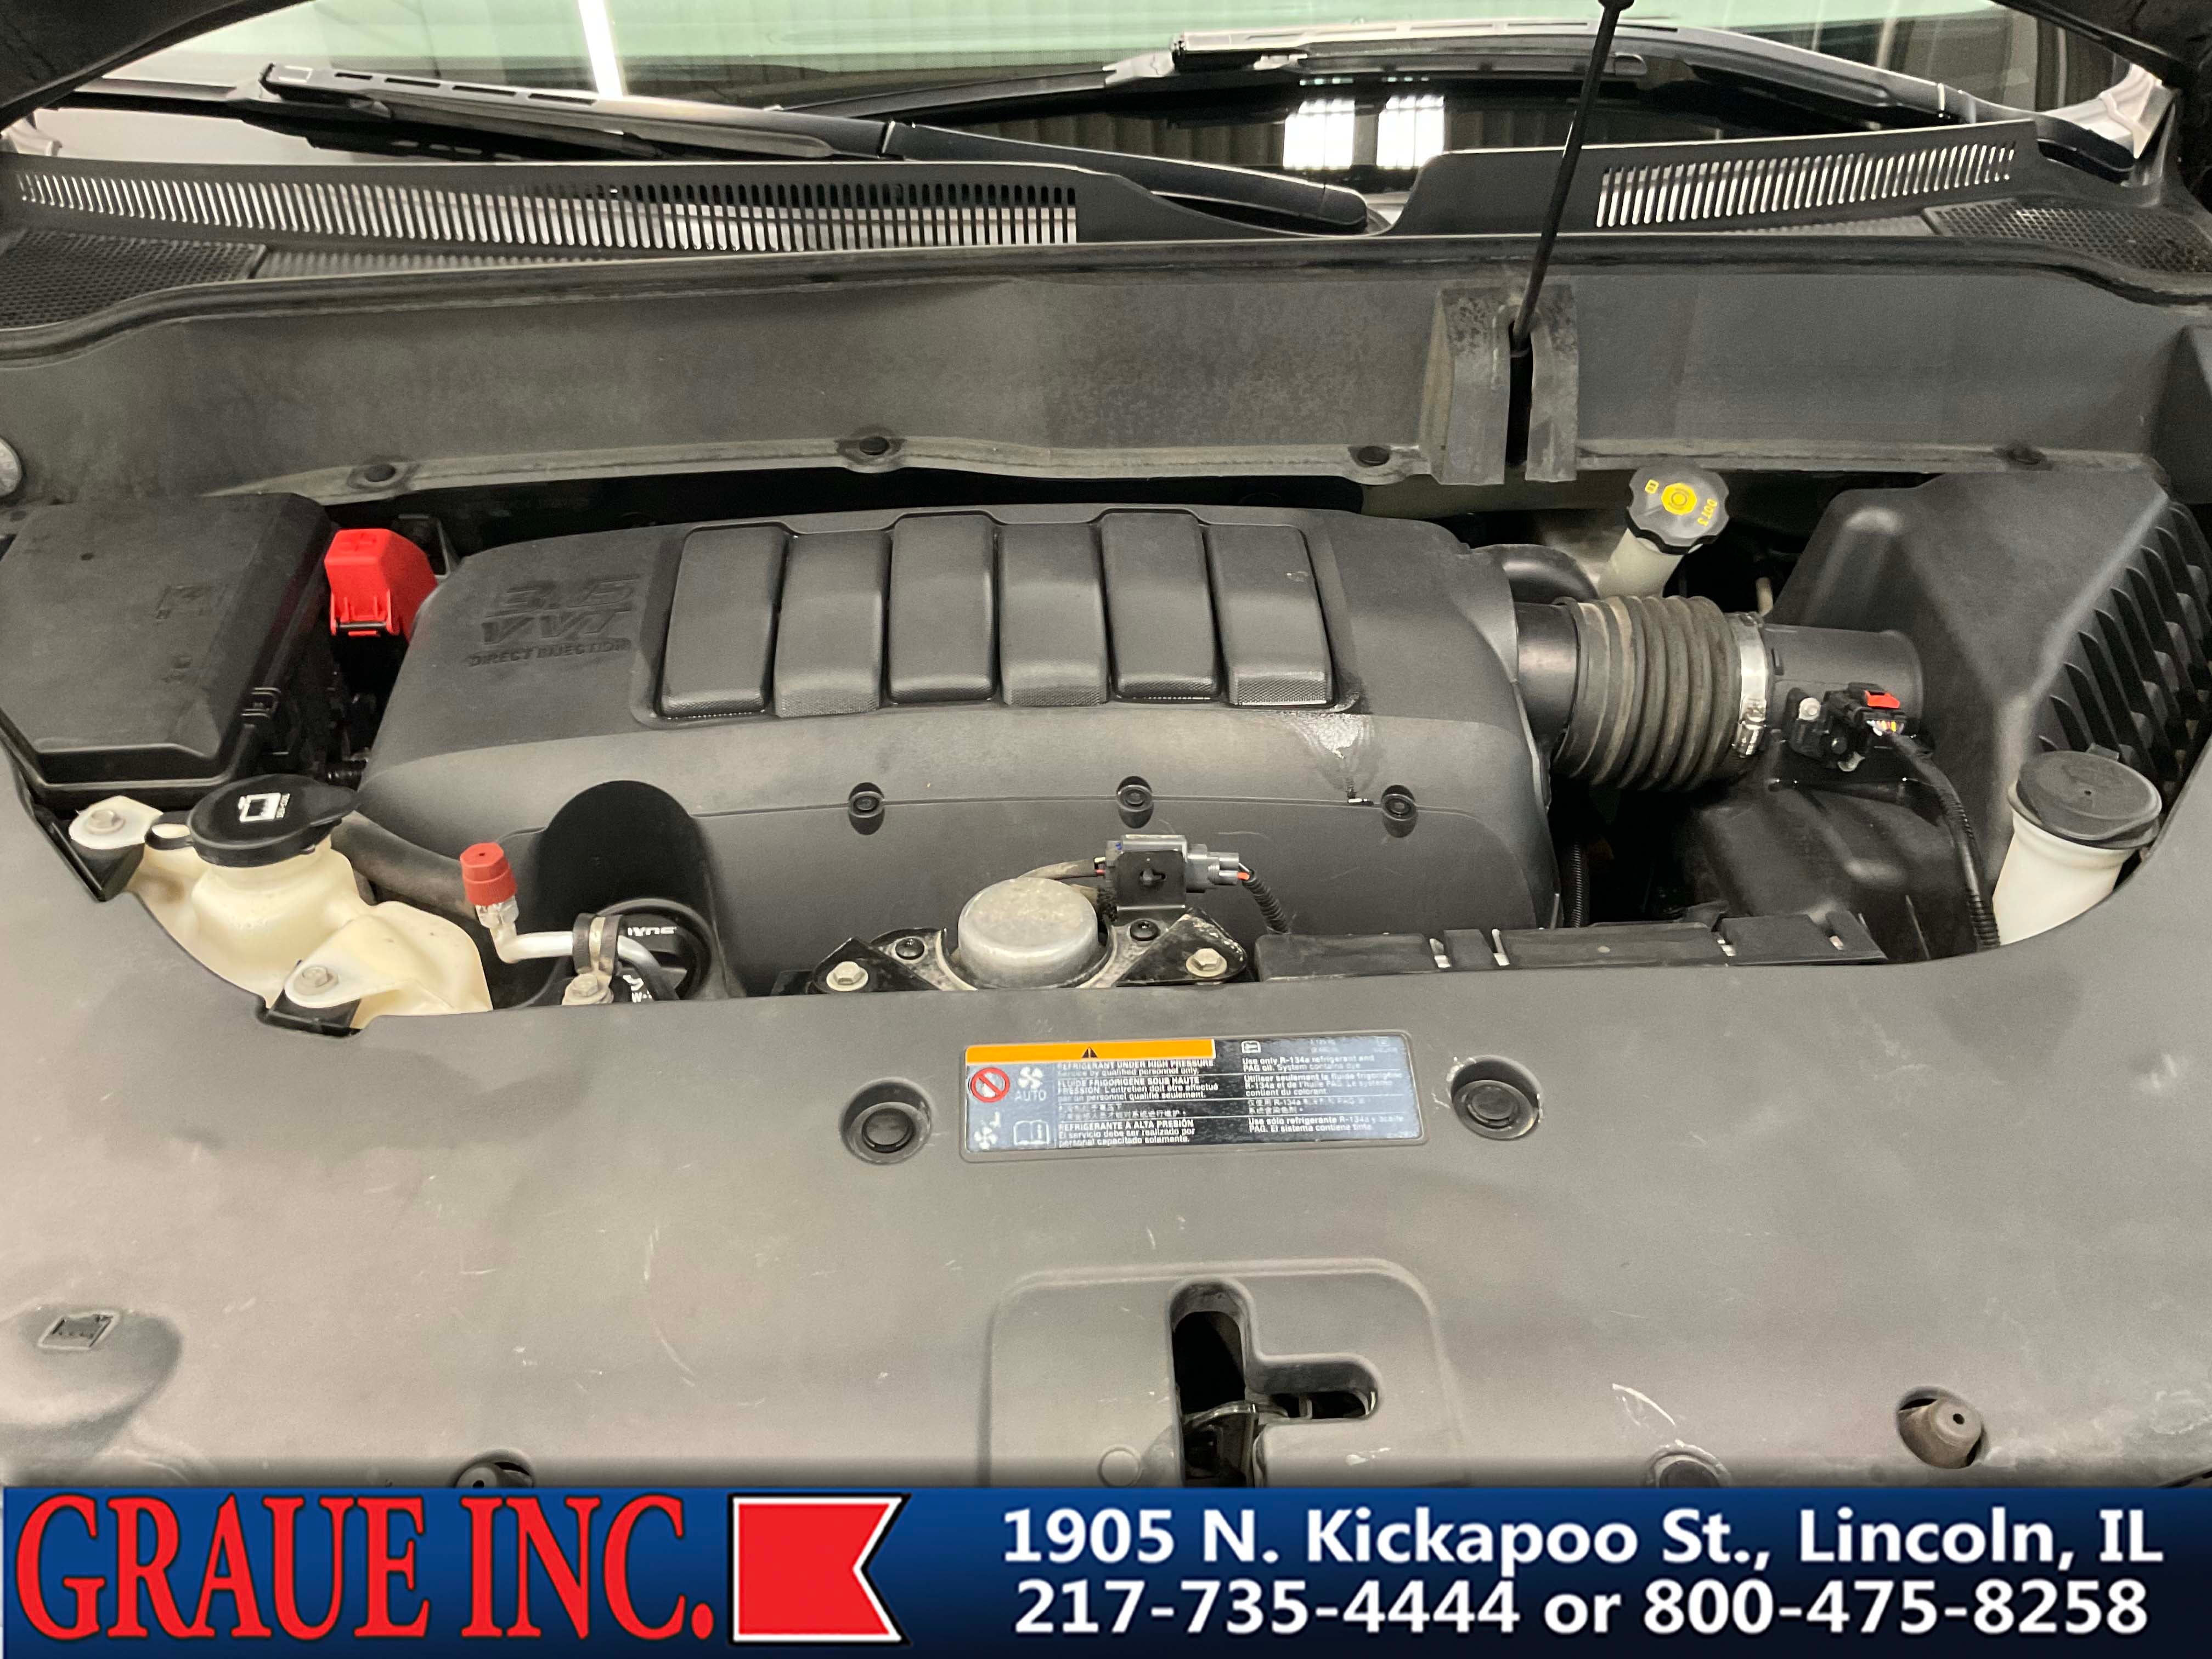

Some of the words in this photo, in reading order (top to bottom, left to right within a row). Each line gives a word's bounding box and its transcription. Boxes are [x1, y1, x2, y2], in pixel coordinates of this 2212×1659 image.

[1260, 1057, 1278, 1065] only
[1015, 1090, 1047, 1102] AUTO
[1125, 1121, 1132, 1130] A
